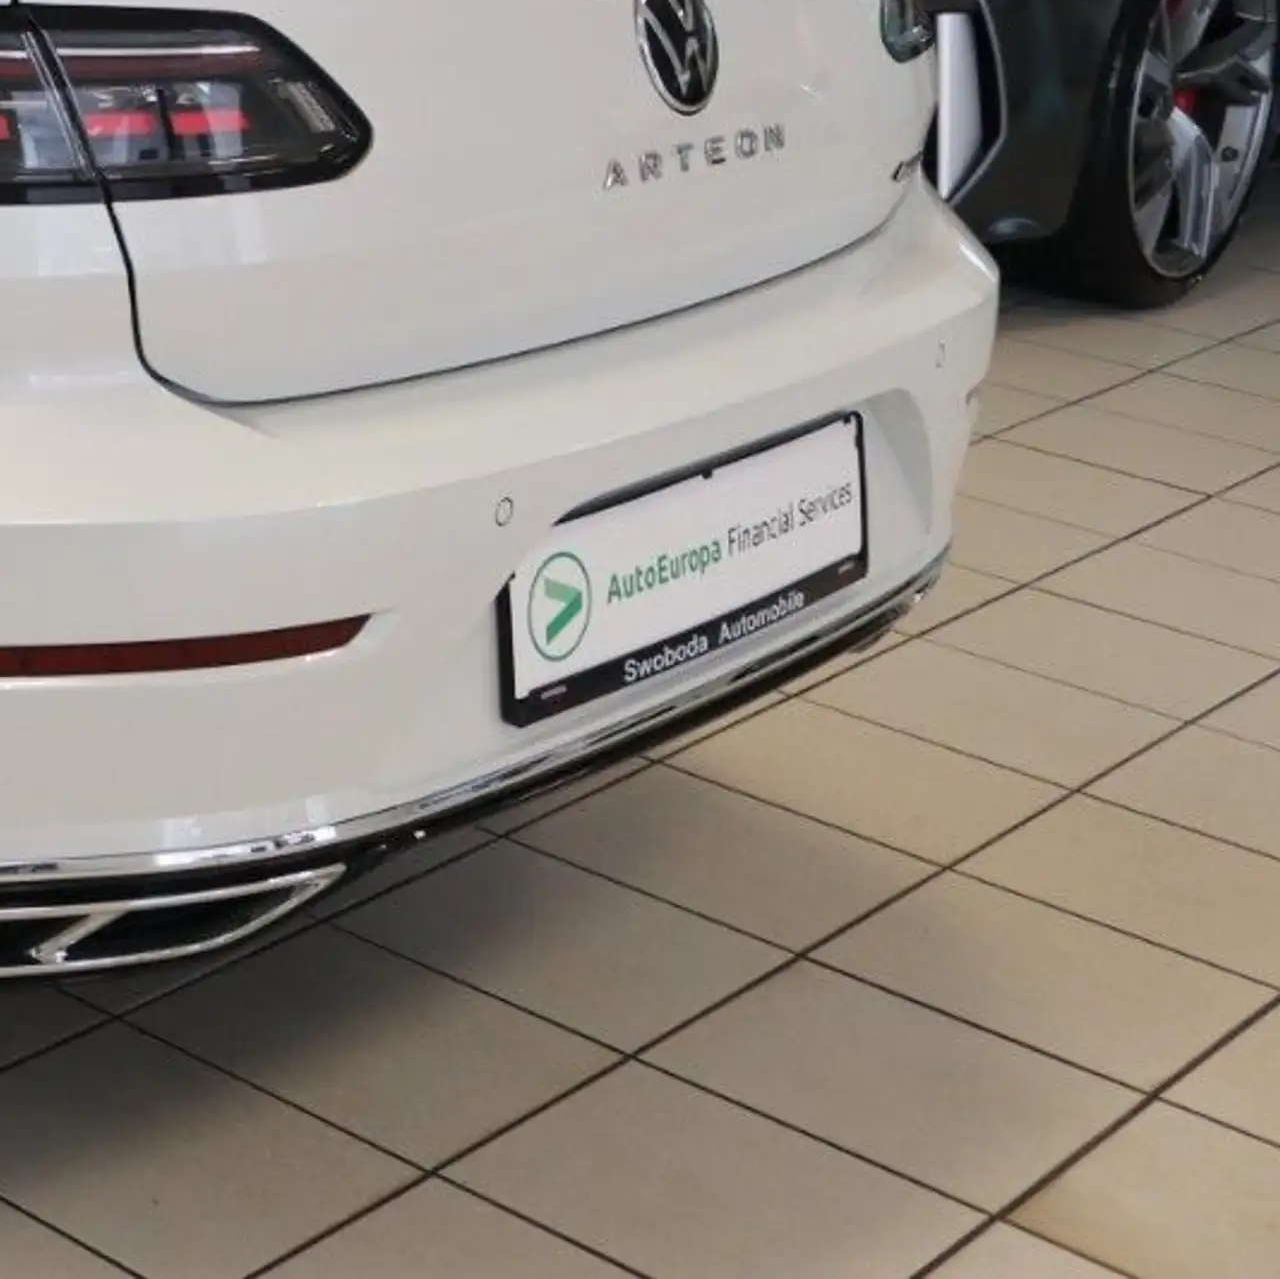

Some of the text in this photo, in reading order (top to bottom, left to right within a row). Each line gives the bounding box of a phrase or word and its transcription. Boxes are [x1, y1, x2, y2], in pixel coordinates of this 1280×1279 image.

[603, 123, 785, 190] ARTEON
[607, 482, 853, 604] AutoEuropa Financial Services
[624, 589, 805, 683] Swoboda Automobile
